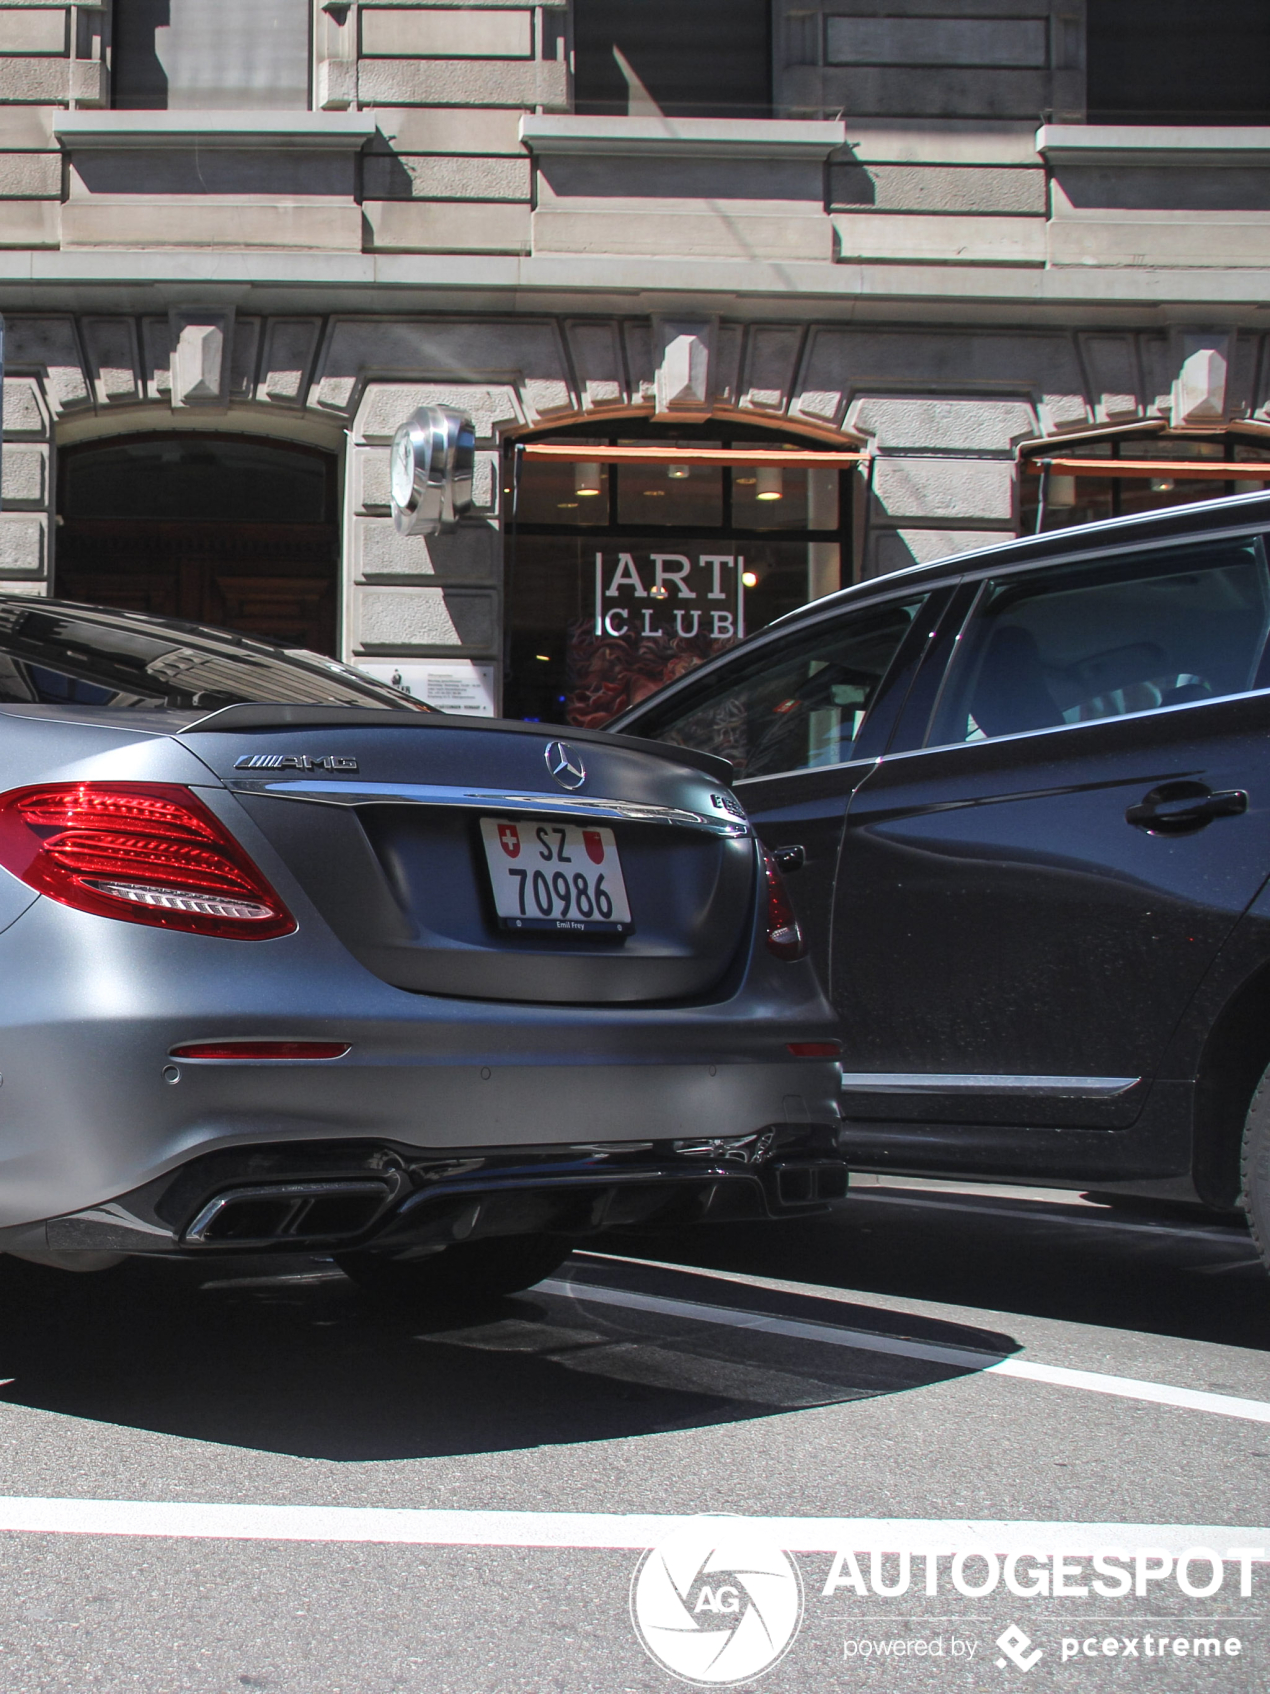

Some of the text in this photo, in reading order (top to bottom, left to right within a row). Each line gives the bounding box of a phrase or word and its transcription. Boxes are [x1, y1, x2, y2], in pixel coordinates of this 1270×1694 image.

[605, 553, 735, 599] ART
[605, 608, 734, 638] CLUB
[536, 826, 572, 863] SZ
[508, 868, 613, 920] 70986
[556, 921, 585, 931] Emil Frey
